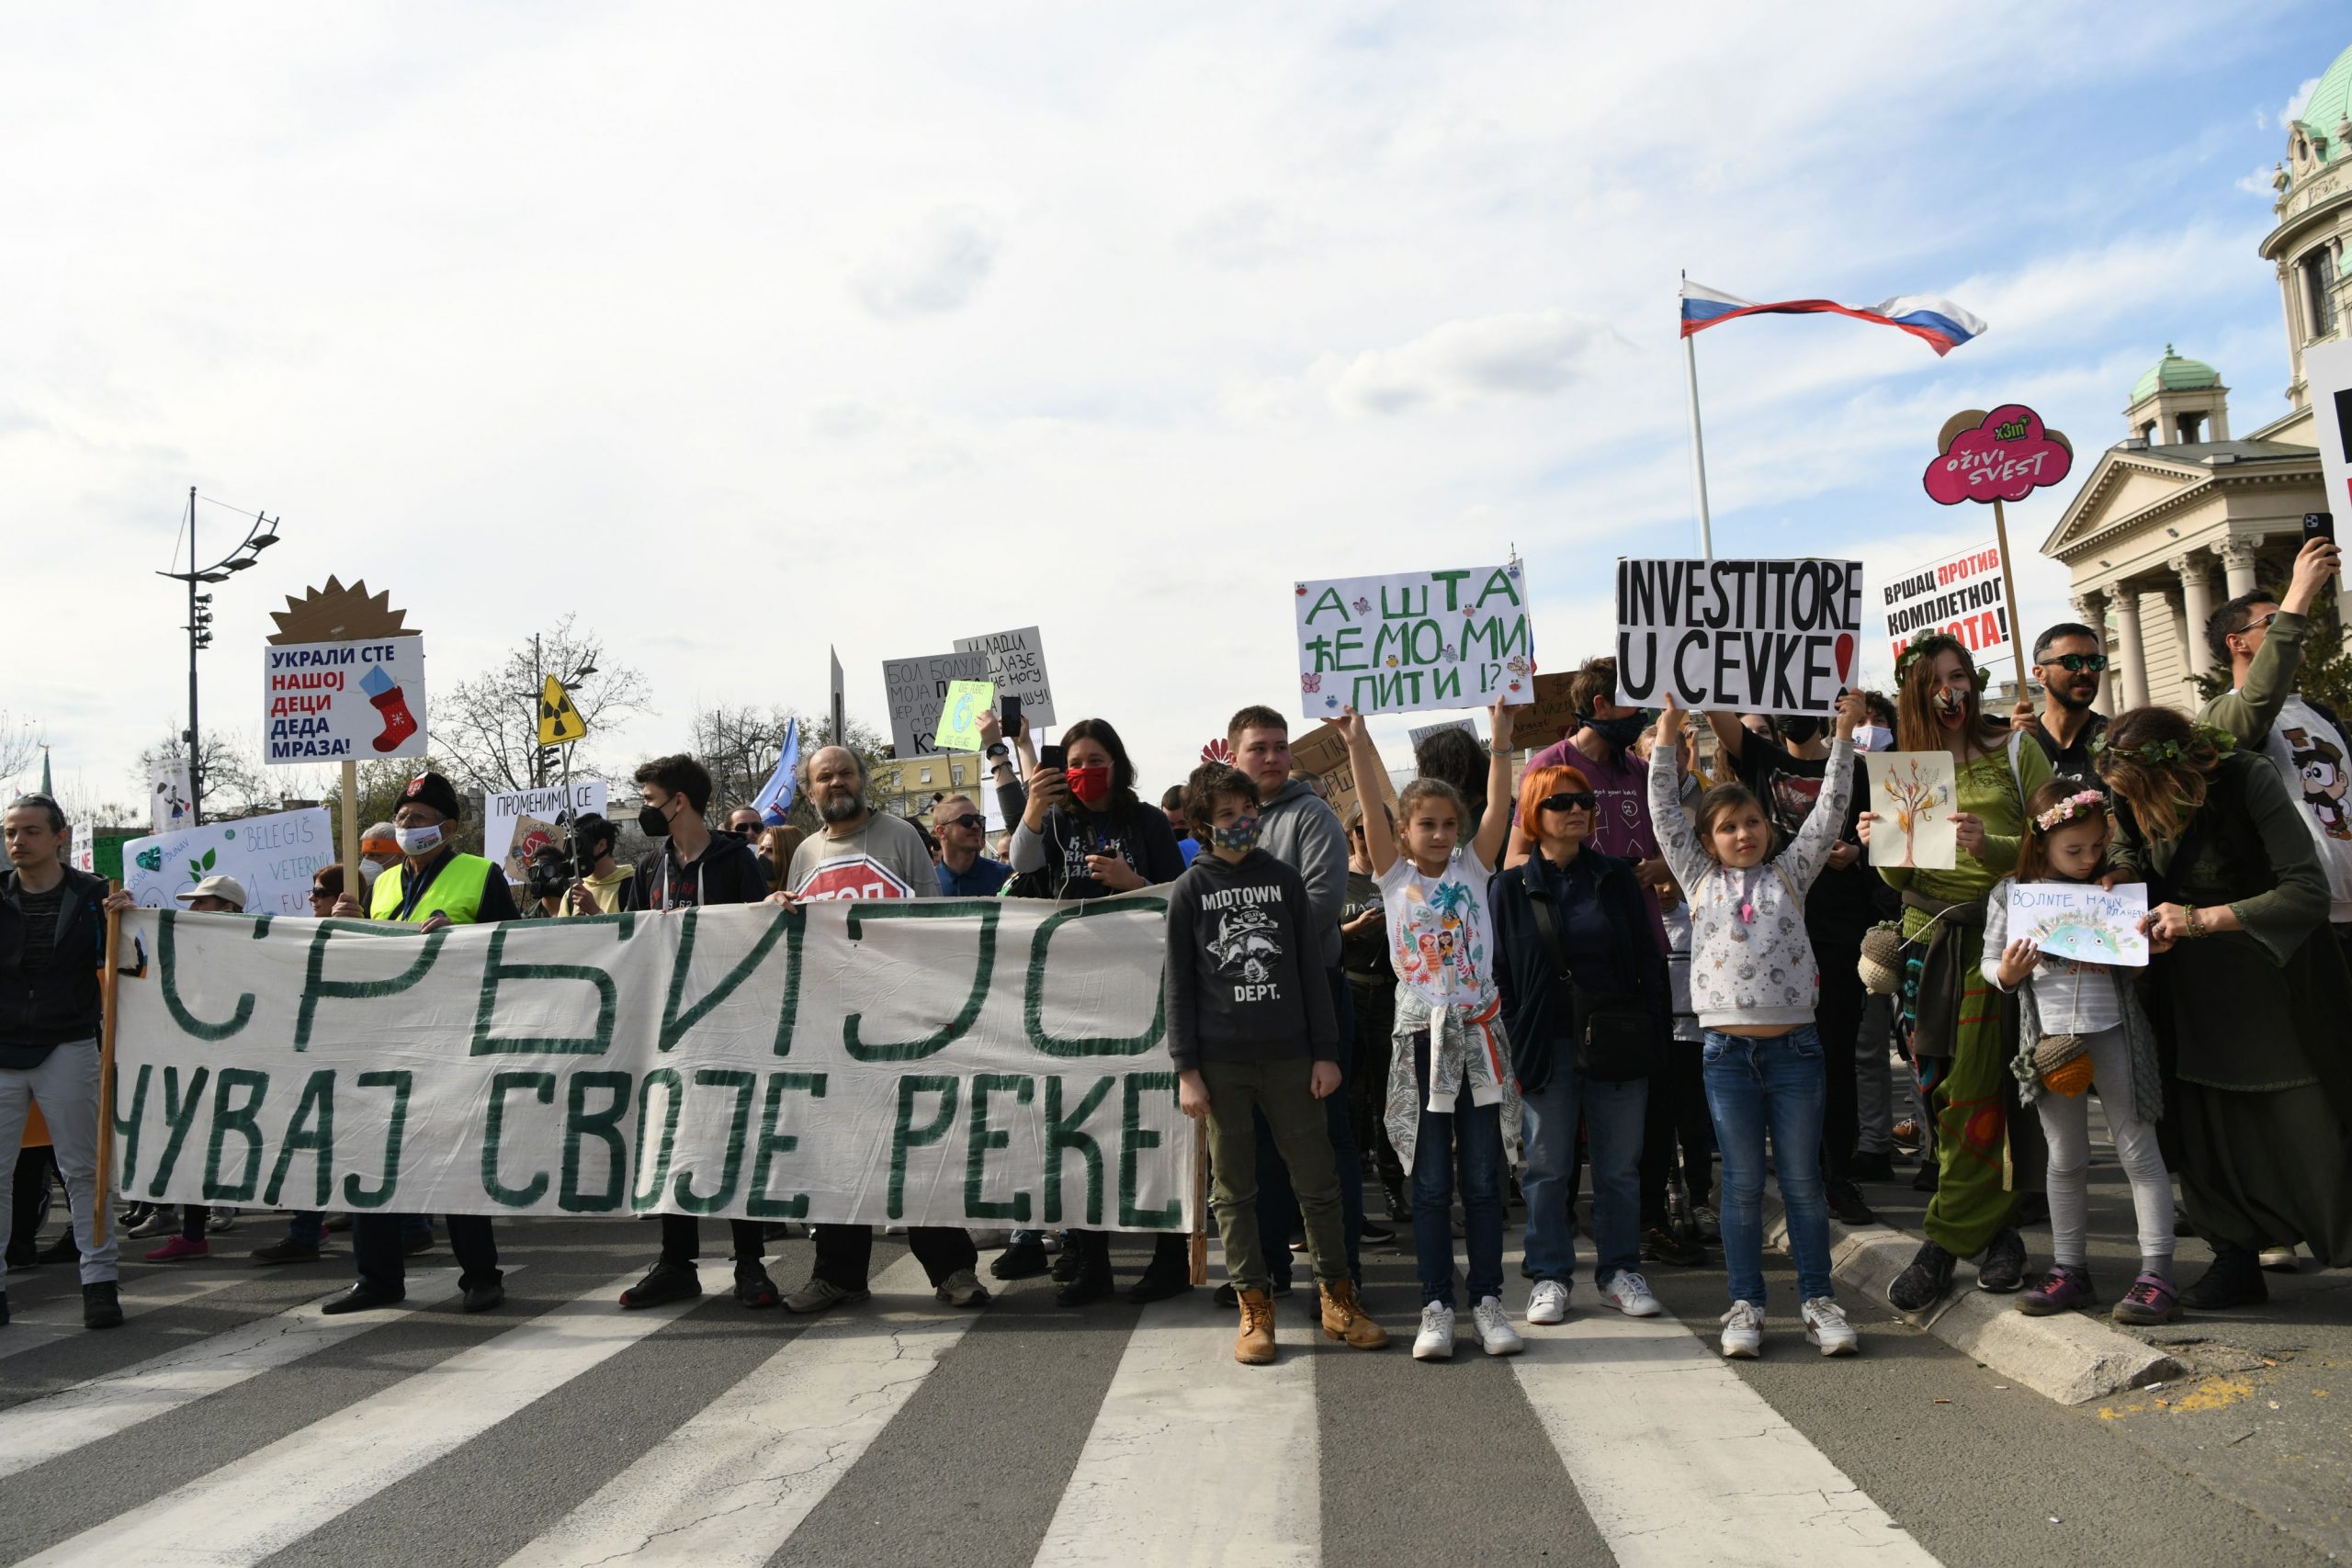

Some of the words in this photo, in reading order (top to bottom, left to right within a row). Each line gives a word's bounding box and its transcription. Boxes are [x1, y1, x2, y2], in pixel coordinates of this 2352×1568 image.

[1947, 449, 2005, 471] OŽIVI
[1968, 451, 2049, 485] SVEST
[1883, 570, 1937, 606] ВРШАЦ
[1938, 548, 1999, 586] ПРОТИВ
[1305, 587, 1351, 626] А
[1381, 568, 1521, 620] ШТА
[1619, 560, 1863, 631] INVESTITORE
[1887, 577, 2002, 637] КОМПЛЕТНОГ
[1306, 618, 1443, 673] ЋЕМО
[1460, 614, 1527, 662] МИ
[272, 648, 355, 669] УКРАЛИ
[361, 645, 395, 663] СТЕ
[272, 671, 345, 692] НАШОЈ
[887, 663, 923, 684] БОЛ
[1010, 668, 1041, 685] МОГУ
[1619, 632, 1657, 701] U
[1673, 629, 1854, 712] CEVKE!
[890, 683, 931, 703] МОЈА
[1352, 666, 1461, 713] ПИТИ
[271, 694, 332, 717] ДЕЦИ
[893, 705, 912, 720] ЈЕР
[920, 703, 938, 716] ИХ
[271, 717, 330, 739] ДЕДА
[272, 739, 350, 758] МРАЗА!
[497, 789, 570, 817] ПРОМЕНИМО
[577, 786, 592, 807] СЕ
[164, 838, 190, 863] DUNAV
[1201, 886, 1282, 910] MIDTOWN
[1234, 983, 1281, 1002] DEPT.
[113, 1064, 413, 1207] ЧУВАЈ
[481, 1067, 828, 1219] СВОЈЕ
[887, 1071, 1183, 1228] РЕКЕ
